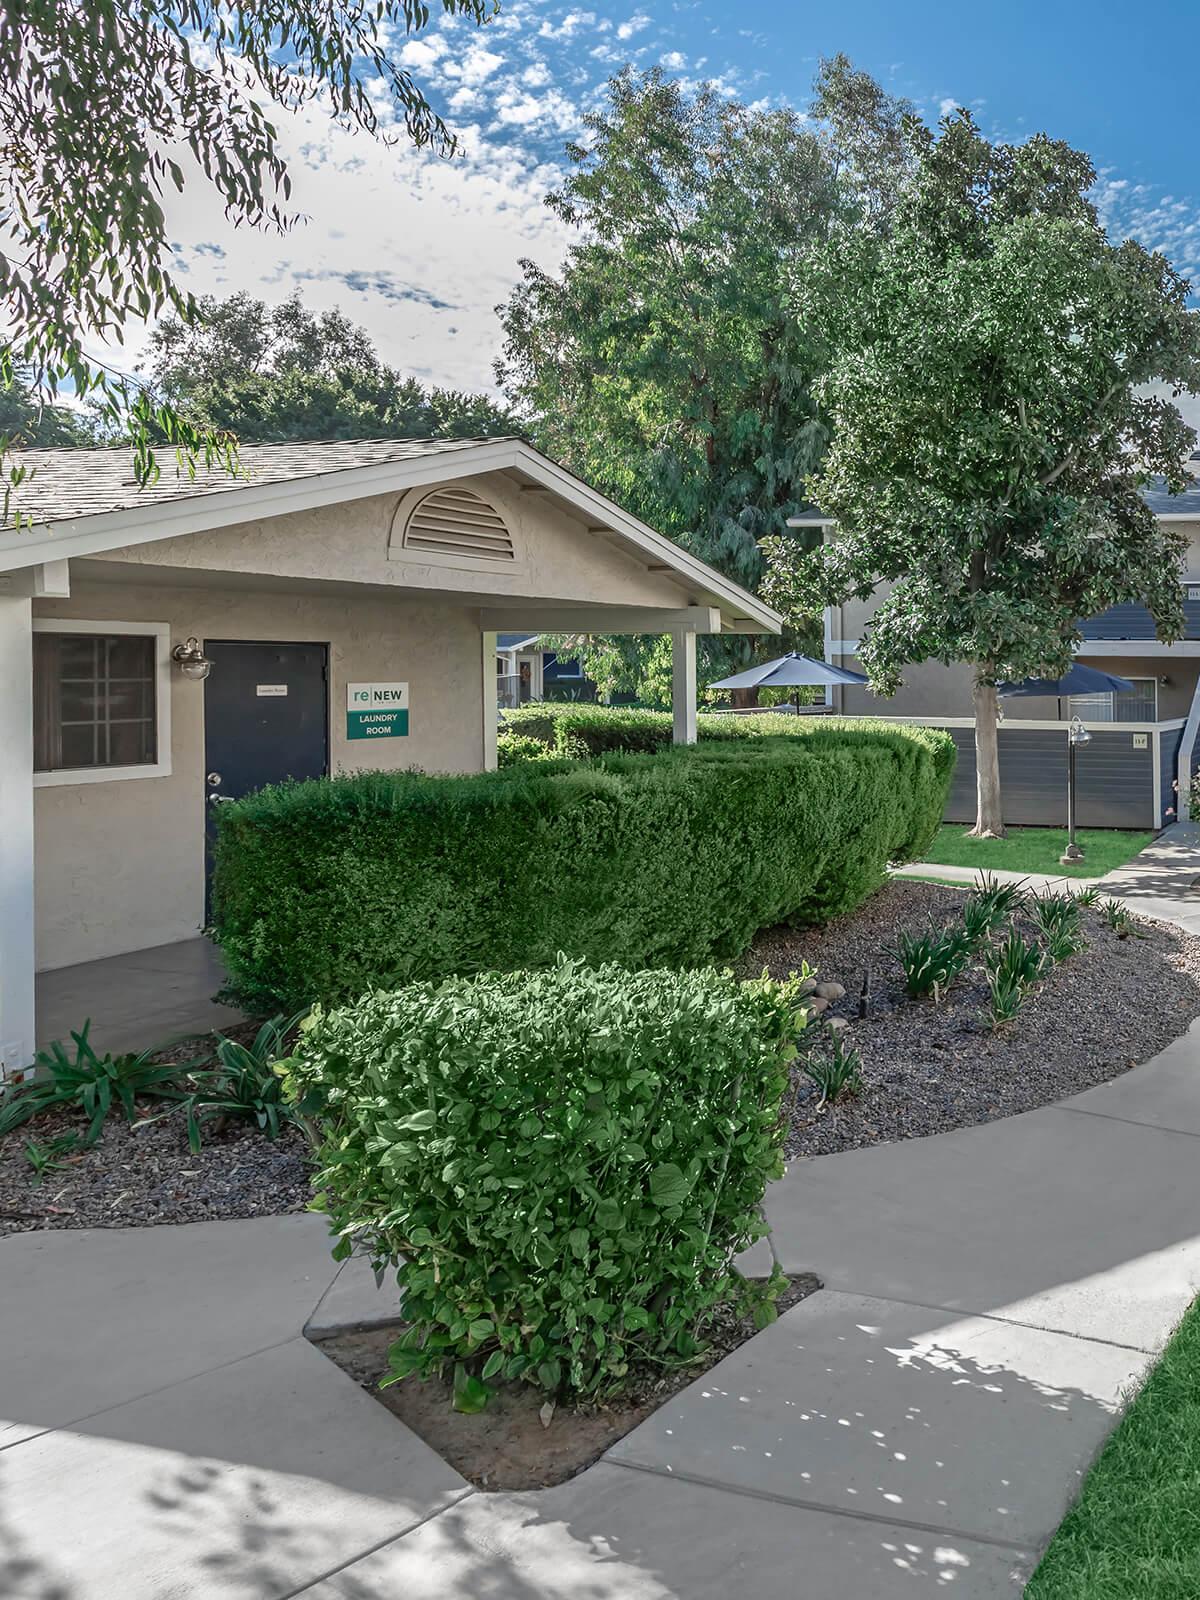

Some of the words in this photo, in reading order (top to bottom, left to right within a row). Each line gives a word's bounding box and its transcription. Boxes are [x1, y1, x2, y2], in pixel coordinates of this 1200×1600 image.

[354, 691, 369, 701] re
[374, 690, 402, 700] NEW
[359, 713, 397, 723] LAUNDRY
[366, 726, 391, 735] ROOM
